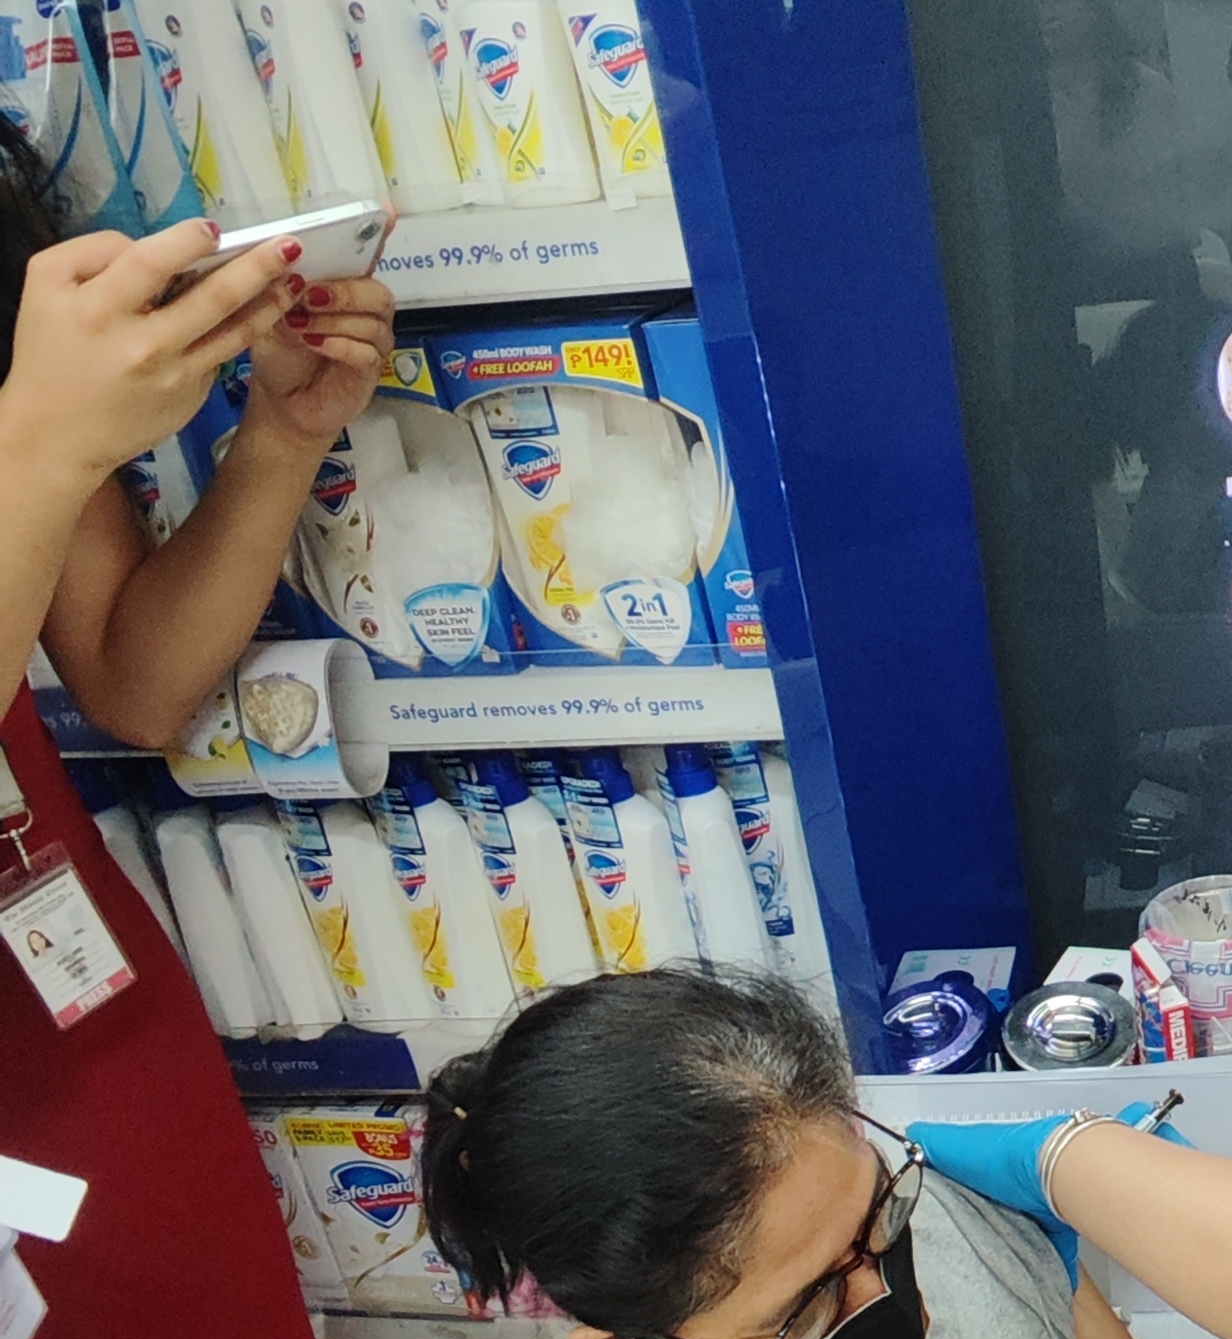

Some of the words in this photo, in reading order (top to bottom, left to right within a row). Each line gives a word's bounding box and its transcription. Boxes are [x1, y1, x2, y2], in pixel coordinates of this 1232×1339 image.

[378, 253, 434, 272] moves
[438, 244, 503, 267] 99.9%
[509, 240, 529, 261] of
[535, 241, 599, 264] germs
[480, 363, 505, 376] FREE
[506, 360, 553, 374] LOOFAH
[503, 446, 561, 480] Safeguard
[621, 592, 668, 617] 2in1
[390, 702, 477, 724] Safeguard
[482, 702, 557, 718] removes
[561, 698, 619, 716] 99.9%
[623, 697, 640, 714] of
[649, 697, 704, 716] germs
[272, 1060, 319, 1075] germs
[326, 1177, 414, 1205] Safeguard
